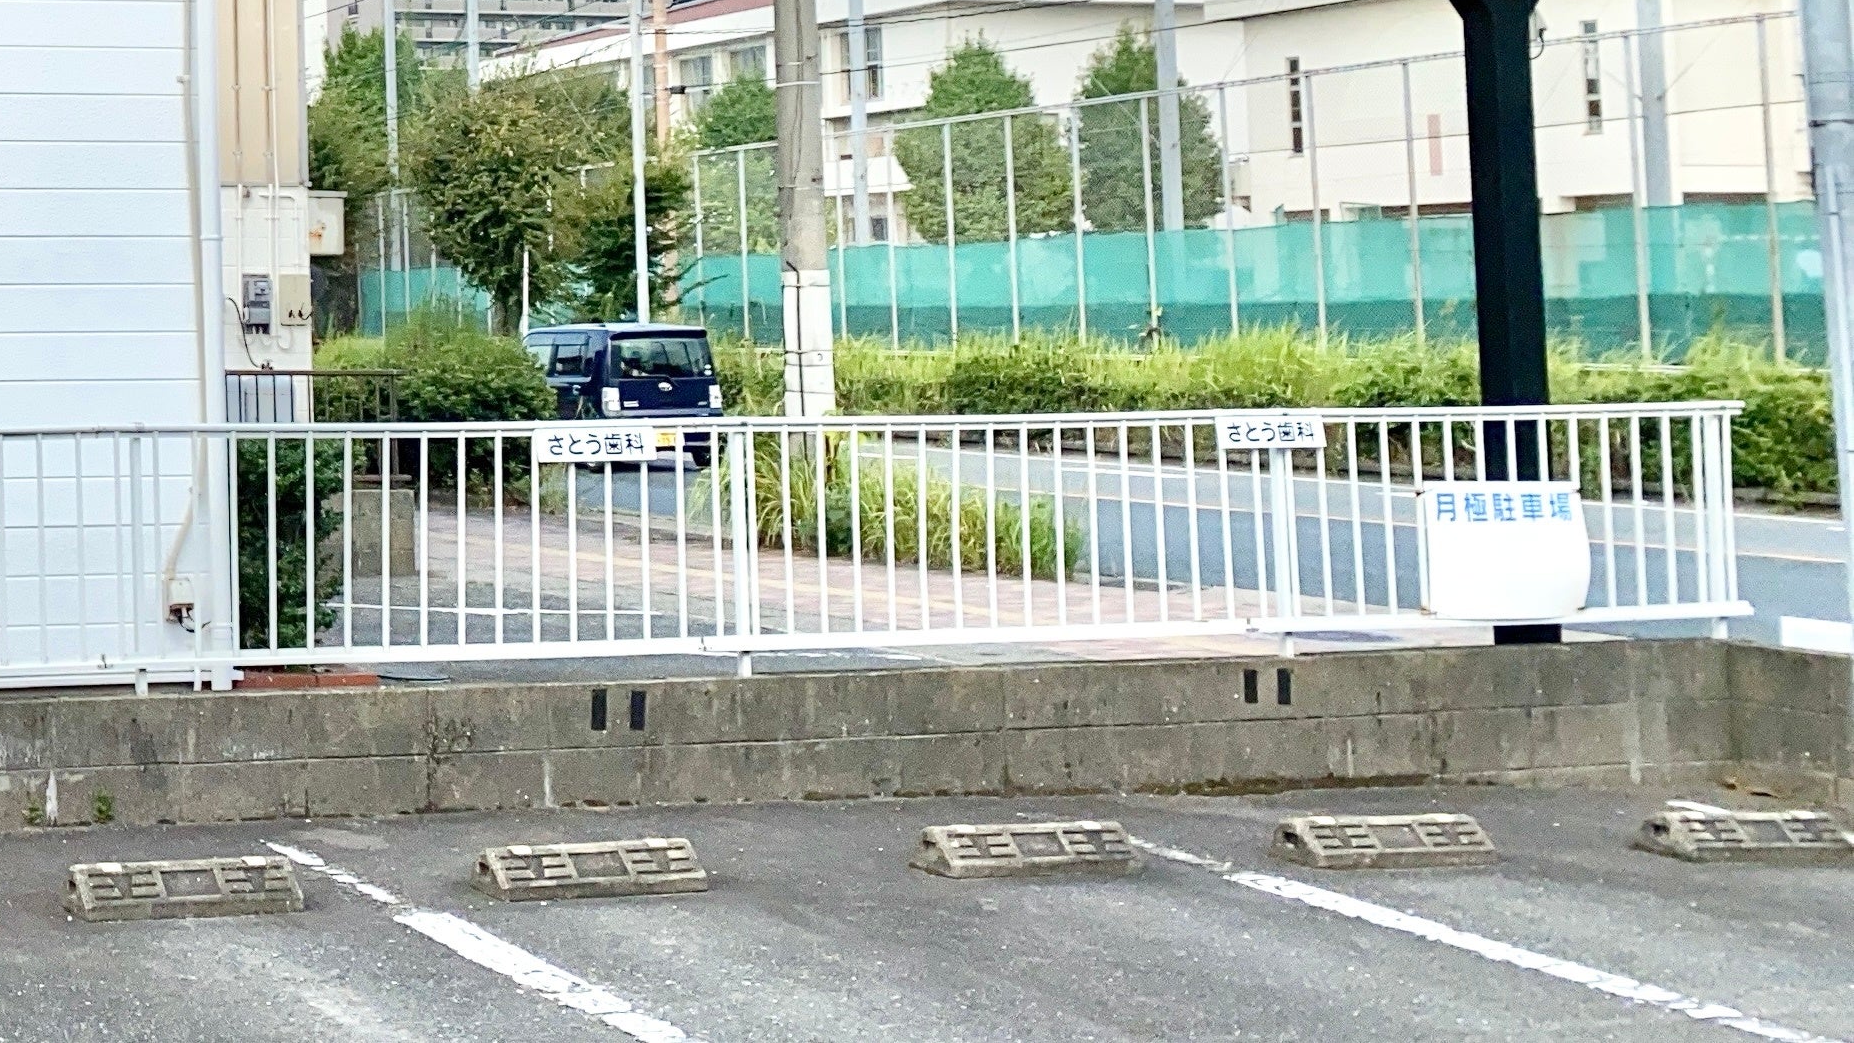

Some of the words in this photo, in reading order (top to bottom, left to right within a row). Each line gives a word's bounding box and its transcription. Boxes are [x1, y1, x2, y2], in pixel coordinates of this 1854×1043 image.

[1226, 421, 1315, 442] さとう歯科
[548, 432, 644, 455] さとう歯科
[1436, 492, 1573, 522] 月極駐車場
